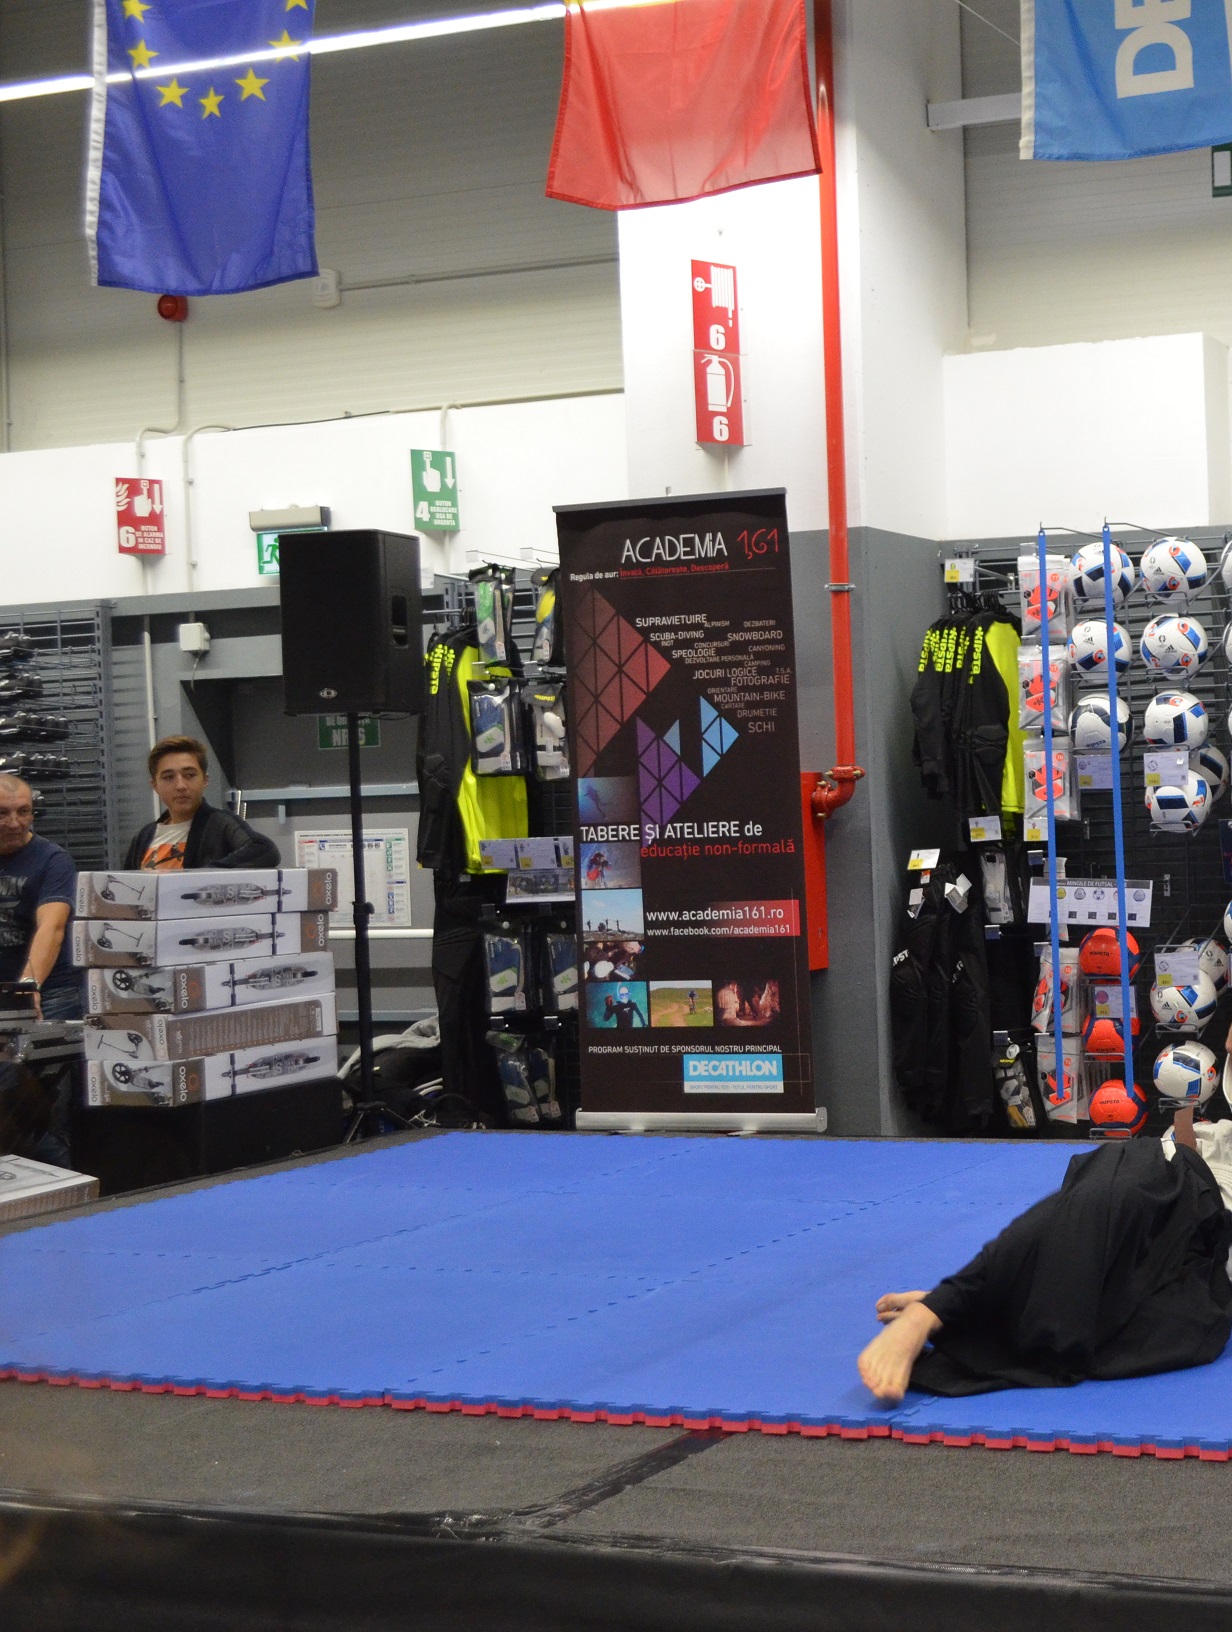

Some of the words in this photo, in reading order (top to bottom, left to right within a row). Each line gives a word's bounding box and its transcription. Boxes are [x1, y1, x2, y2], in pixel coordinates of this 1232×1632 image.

[709, 324, 726, 350] 6
[712, 416, 730, 441] 6
[415, 501, 431, 522] 4
[119, 525, 137, 548] 6
[570, 572, 594, 582] Regula
[594, 571, 604, 579] de
[604, 571, 619, 579] aur:
[636, 613, 708, 628] SUPRAVIETUIRE
[704, 620, 730, 628] ALPINISM
[743, 619, 776, 628] DEZBATERI
[650, 630, 705, 642] SCUBA-DIVING
[727, 630, 783, 642] SNOWBOARD
[694, 641, 730, 649] CONCURSURI
[748, 644, 786, 652] CANYONING
[672, 648, 716, 659] SPEOLOGIE
[685, 656, 720, 664] DEZVOLTARE
[744, 659, 771, 667] CAMPING
[692, 669, 725, 680] JOCURI
[727, 667, 758, 678] LOGICE
[731, 674, 790, 686] FOTOGRAFIE
[707, 686, 738, 694] ORIENTARE
[714, 691, 786, 702] MOUNTAIN-BIKE
[748, 721, 775, 733] SCHI
[580, 824, 640, 842] TABERE
[664, 821, 740, 839] ATELIERE
[744, 821, 763, 836] de
[324, 872, 333, 905] oxelo
[646, 906, 784, 921] www.academia161.ro
[316, 913, 325, 947] oxelo
[646, 924, 790, 936] www.facebook.com/academia161
[180, 973, 188, 1009] oxelo
[588, 1045, 623, 1054] PROGRAM
[660, 1045, 670, 1053] DE
[671, 1044, 714, 1053] SPONSORUL
[714, 1045, 744, 1053] NOSTRU
[745, 1044, 782, 1053] PRINCIPAL
[688, 1060, 778, 1076] DECATHLON
[179, 1066, 188, 1102] oxelo
